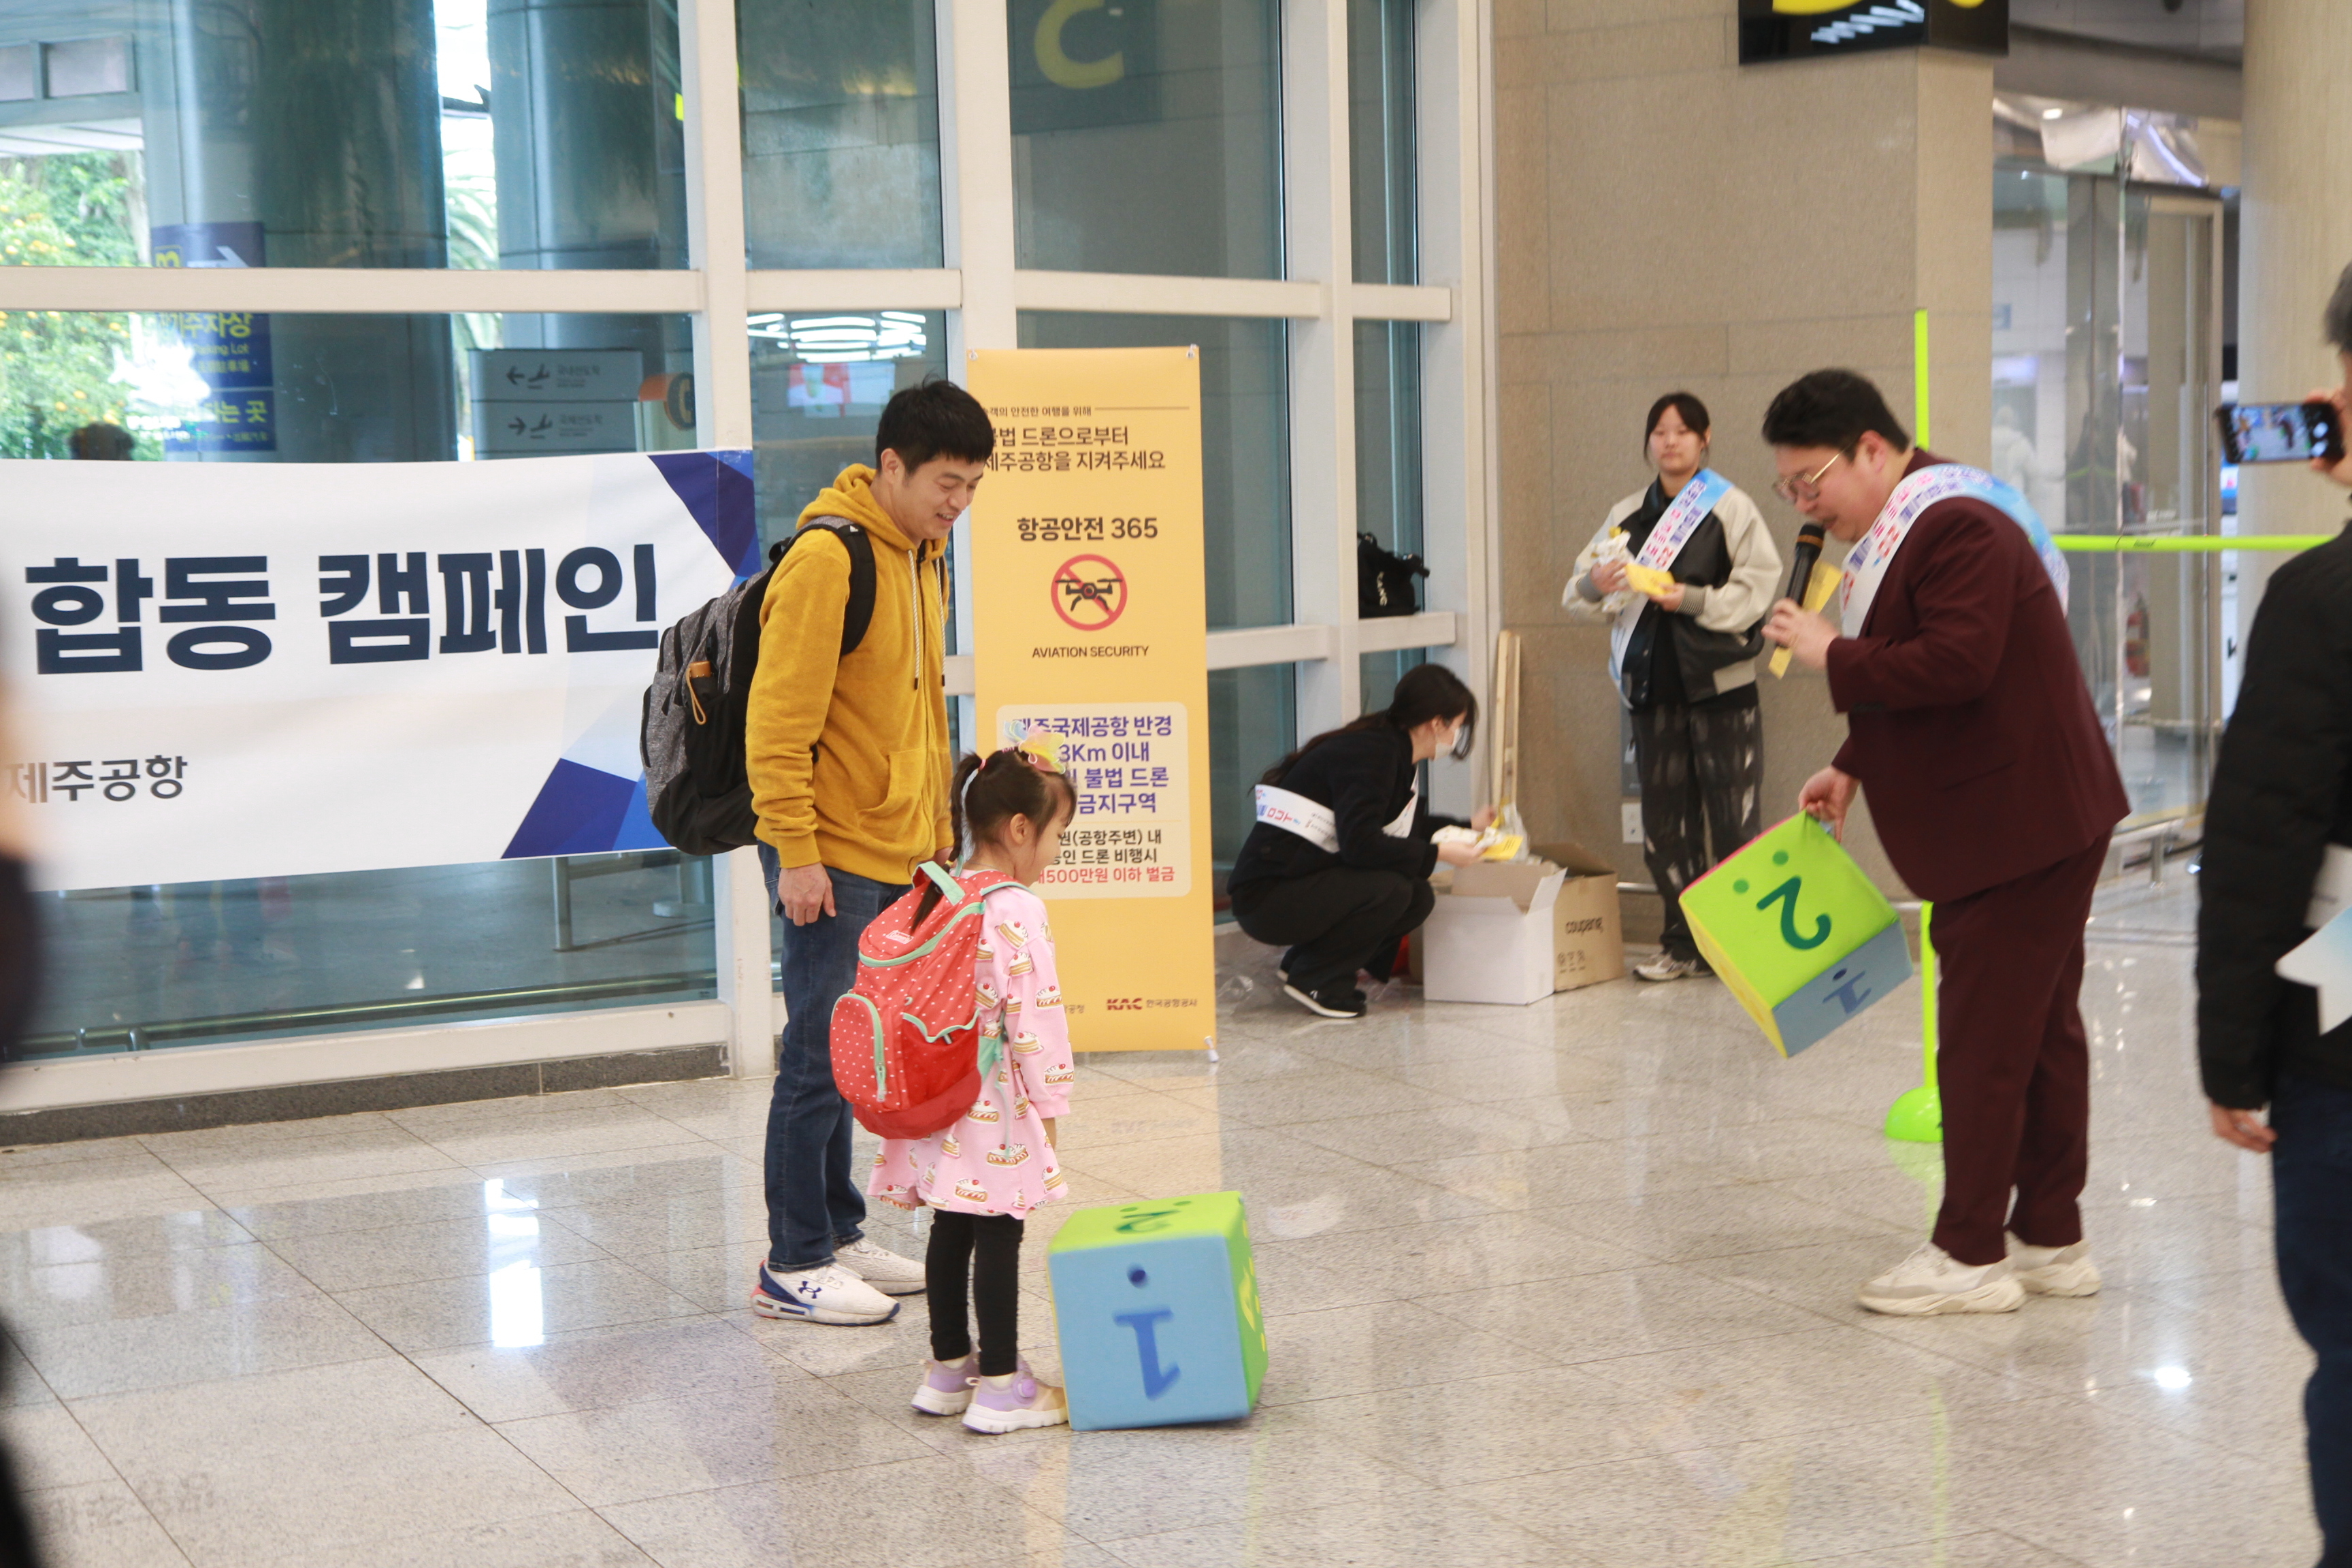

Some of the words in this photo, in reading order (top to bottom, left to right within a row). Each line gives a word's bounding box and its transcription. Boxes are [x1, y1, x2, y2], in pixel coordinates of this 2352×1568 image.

[985, 406, 1008, 417] 객의
[1011, 406, 1039, 417] 안전한
[1073, 406, 1092, 416] 위해
[1022, 426, 1128, 446] 드론으로부터
[1077, 450, 1166, 470] 지켜주세요
[1017, 517, 1105, 541] 항공안전
[1111, 518, 1158, 538] 365
[24, 555, 276, 675] 합동
[318, 543, 660, 665] 캠페인
[1032, 647, 1087, 658] AVIATION
[1090, 645, 1149, 657] SECURITY
[1134, 715, 1172, 736] 반경
[1112, 742, 1149, 762] 이내
[5, 755, 188, 803] 제주공항
[1084, 768, 1122, 788] 불법
[1130, 767, 1169, 787] 드론
[1077, 793, 1156, 814] 금지구역
[1148, 829, 1162, 844] 내
[1081, 849, 1109, 864] 드론
[1115, 848, 1158, 864] 비행시
[1113, 867, 1142, 883] 이하
[1147, 866, 1175, 882] 벌금
[1757, 875, 1832, 951] 2
[1107, 998, 1143, 1011] KAC
[1112, 1304, 1181, 1401] 1
